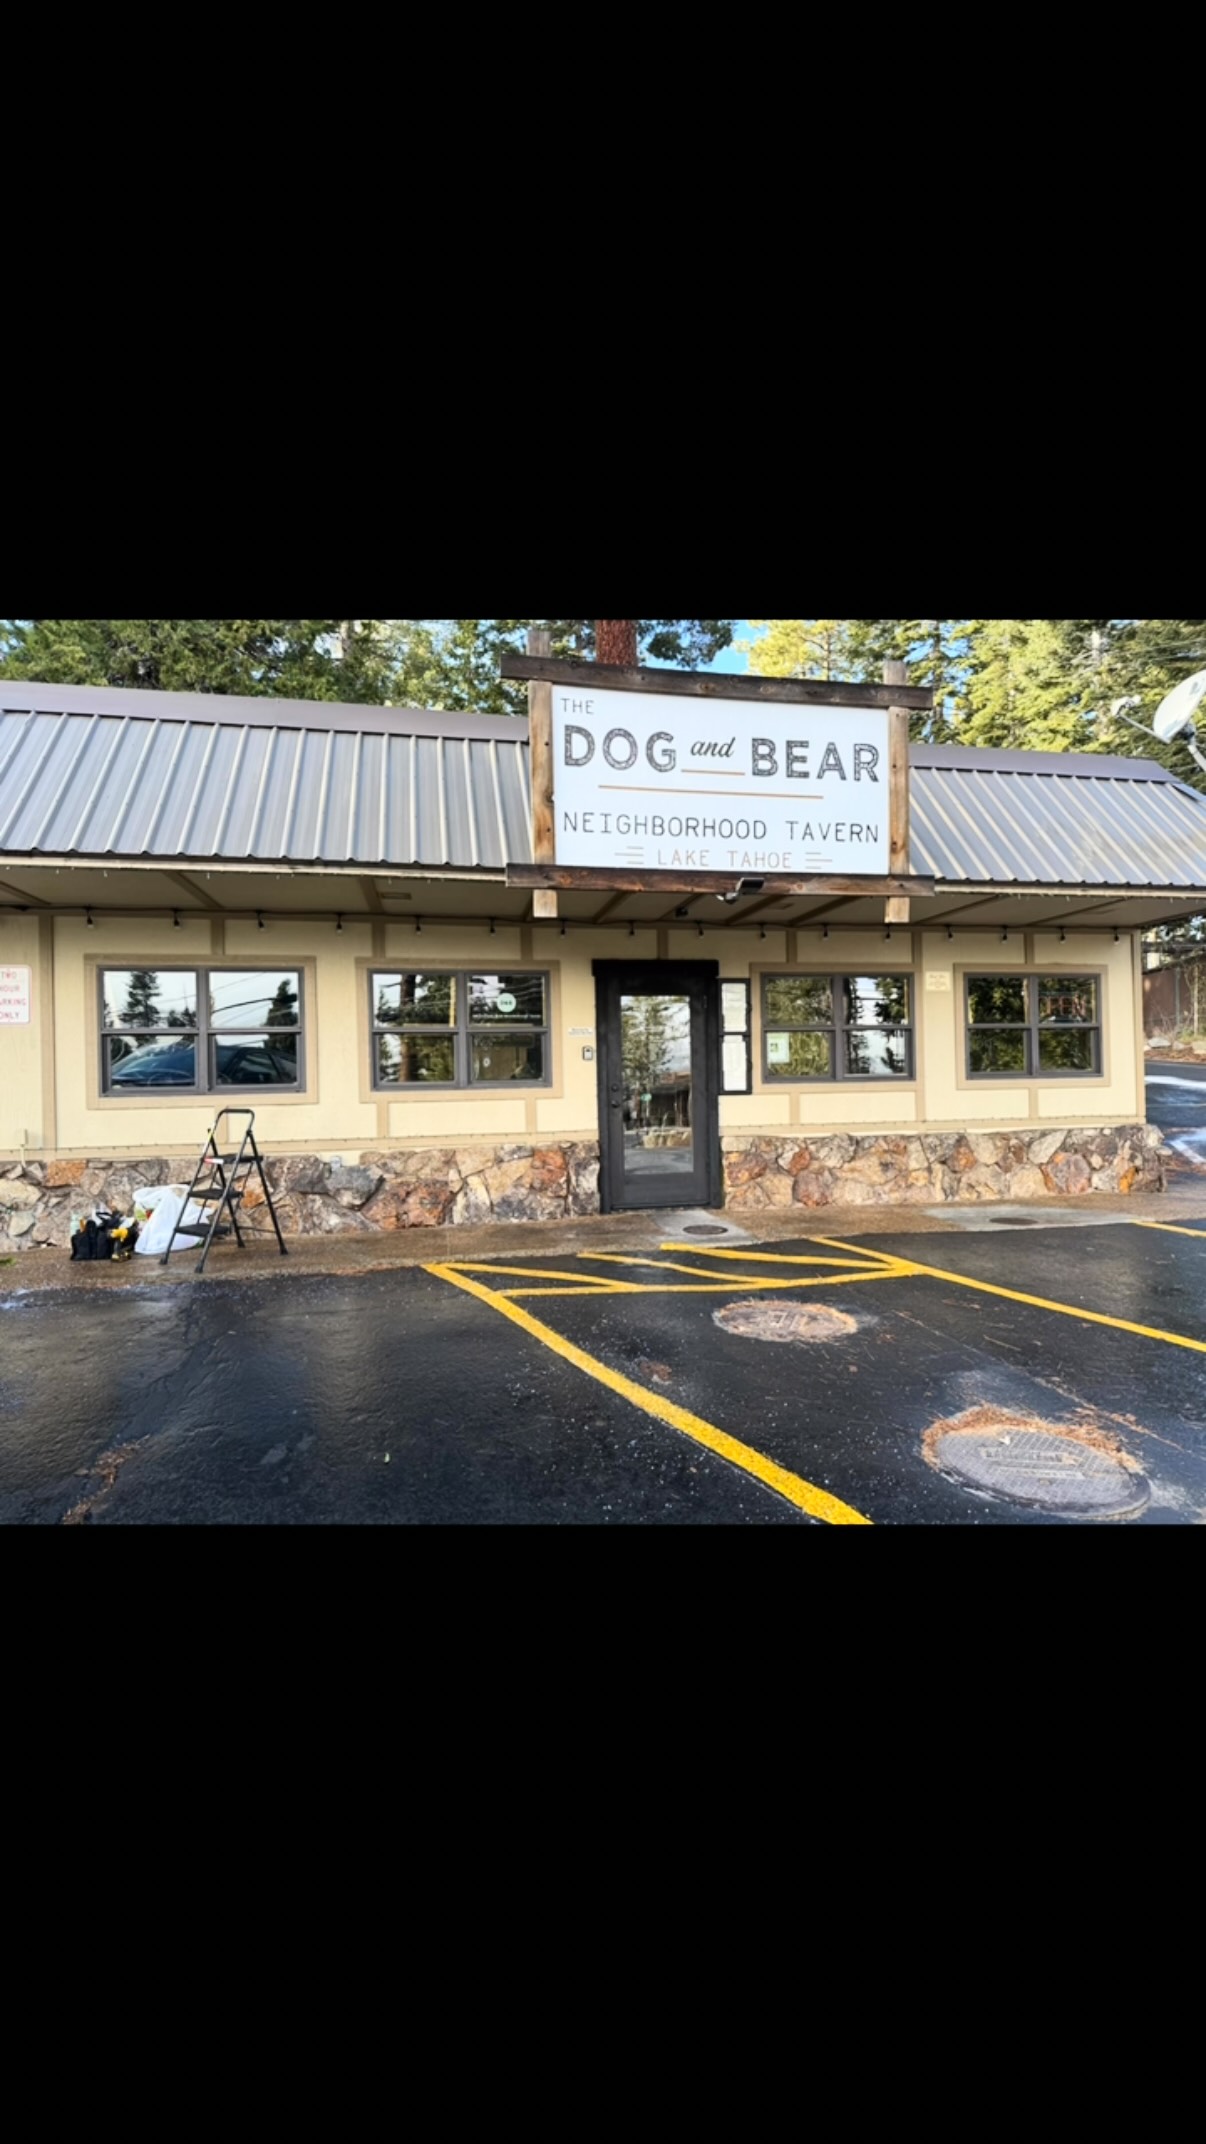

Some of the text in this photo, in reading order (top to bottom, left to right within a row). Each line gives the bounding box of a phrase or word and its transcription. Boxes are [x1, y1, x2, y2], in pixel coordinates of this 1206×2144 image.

[562, 698, 594, 715] THE
[564, 724, 880, 783] DOG and BEAR
[563, 811, 879, 844] NEIGHBORHOOD TAVERN
[657, 848, 793, 869] LAKE TAHOE
